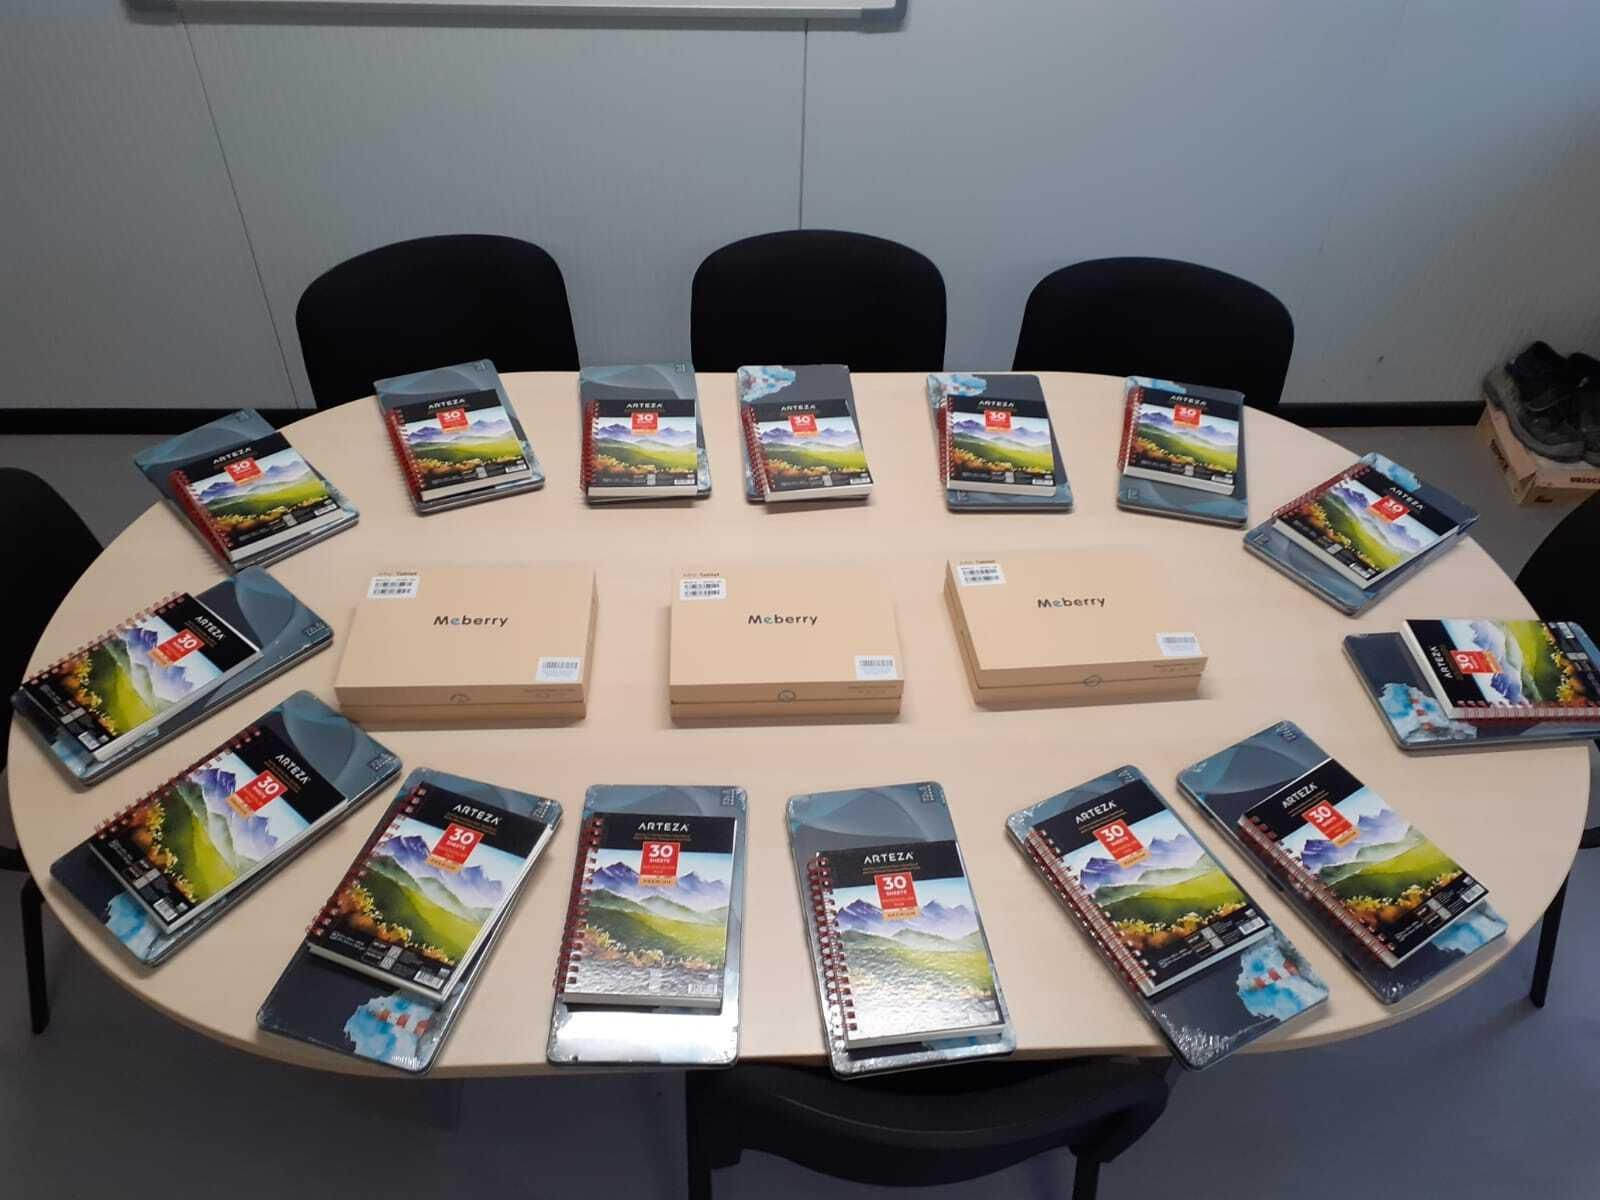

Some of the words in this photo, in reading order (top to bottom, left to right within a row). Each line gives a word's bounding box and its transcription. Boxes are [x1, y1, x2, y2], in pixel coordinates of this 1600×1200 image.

[231, 460, 251, 473] 30
[1037, 597, 1106, 609] Meberry
[194, 615, 226, 641] ARTEZA
[433, 615, 509, 627] Meberry
[748, 614, 818, 626] Meberry
[176, 633, 198, 649] 30
[1456, 654, 1475, 671] 30
[275, 753, 312, 785] ARTEZA
[256, 775, 280, 795] 30
[1282, 782, 1319, 809] ARTEZA
[453, 804, 500, 825] ARTEZA
[1075, 800, 1117, 825] ARTEZA
[1307, 805, 1332, 824] 30
[638, 822, 689, 832] ARTEZA
[1100, 825, 1125, 843] 30
[448, 827, 475, 846] 30
[649, 844, 674, 858] 30
[864, 852, 914, 865] ARTEZA
[882, 876, 907, 890] 30
